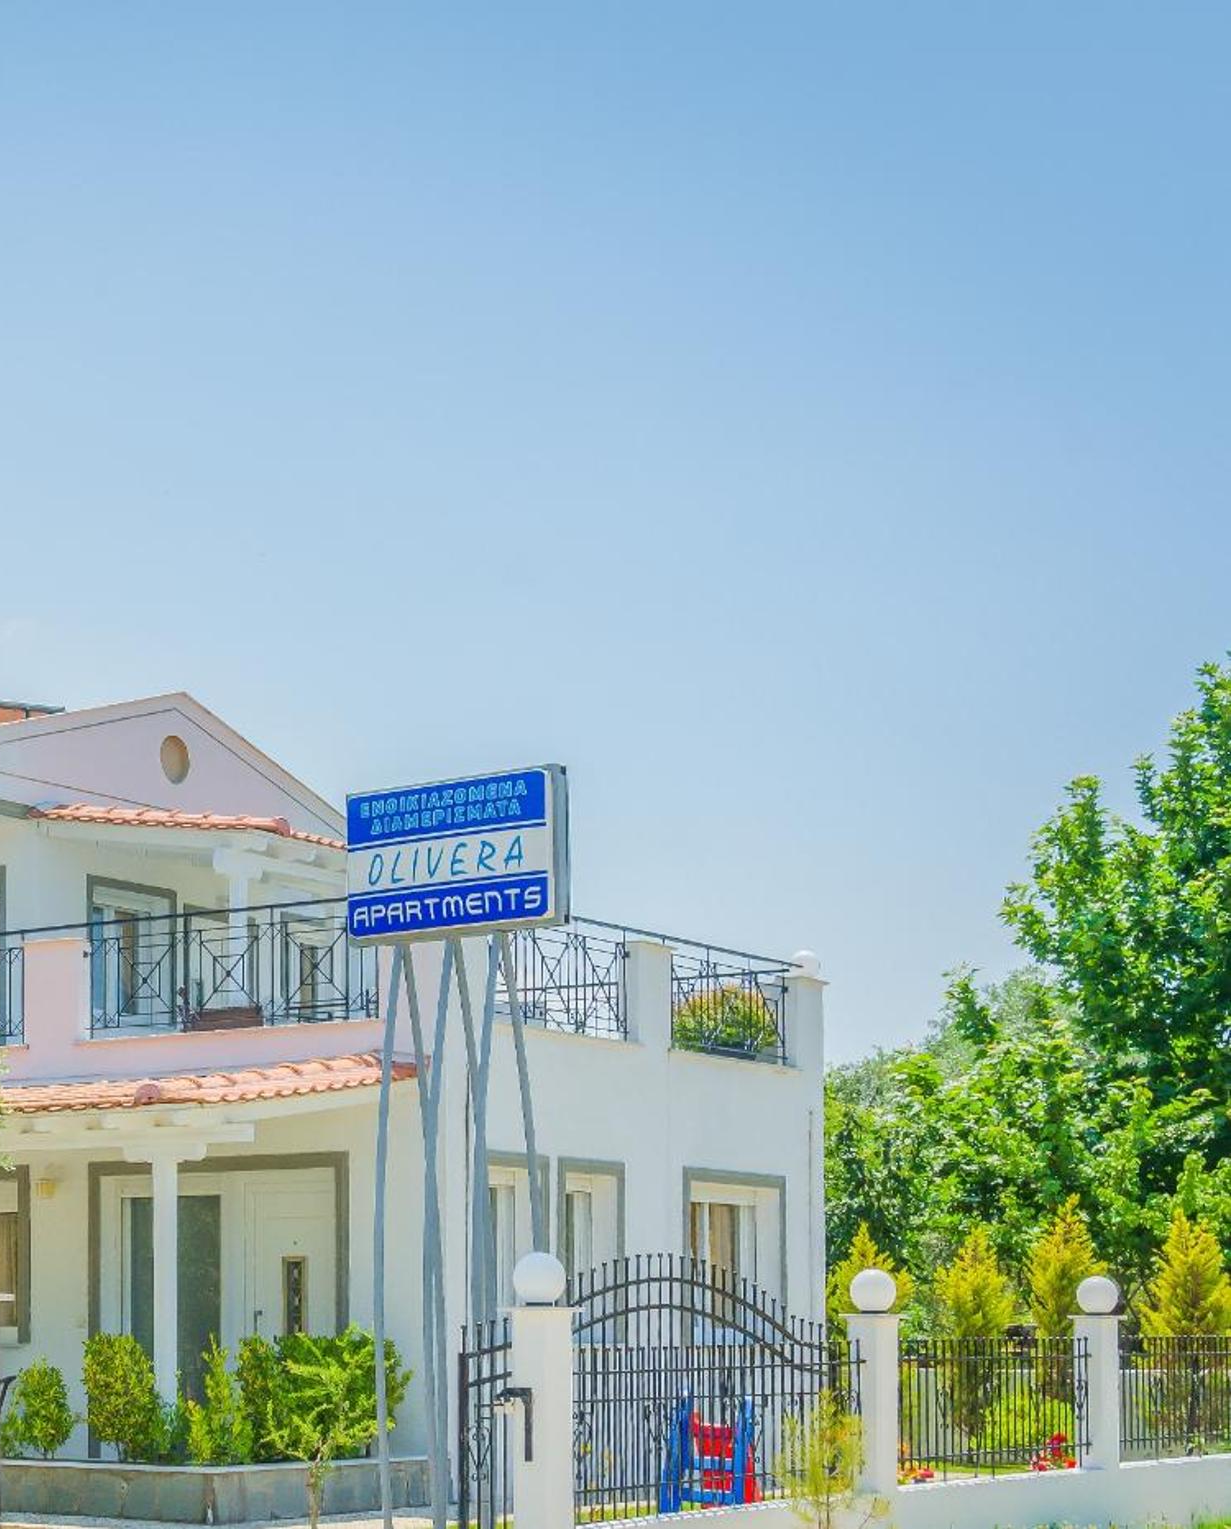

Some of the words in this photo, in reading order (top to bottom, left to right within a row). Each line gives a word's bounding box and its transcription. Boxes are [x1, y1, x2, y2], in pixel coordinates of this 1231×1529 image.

[370, 799, 521, 835] ΔΙΑΜΕΡΙΣΜΑΤΑ
[368, 835, 524, 885] OLIVERA
[353, 886, 541, 928] APARTMENTS
